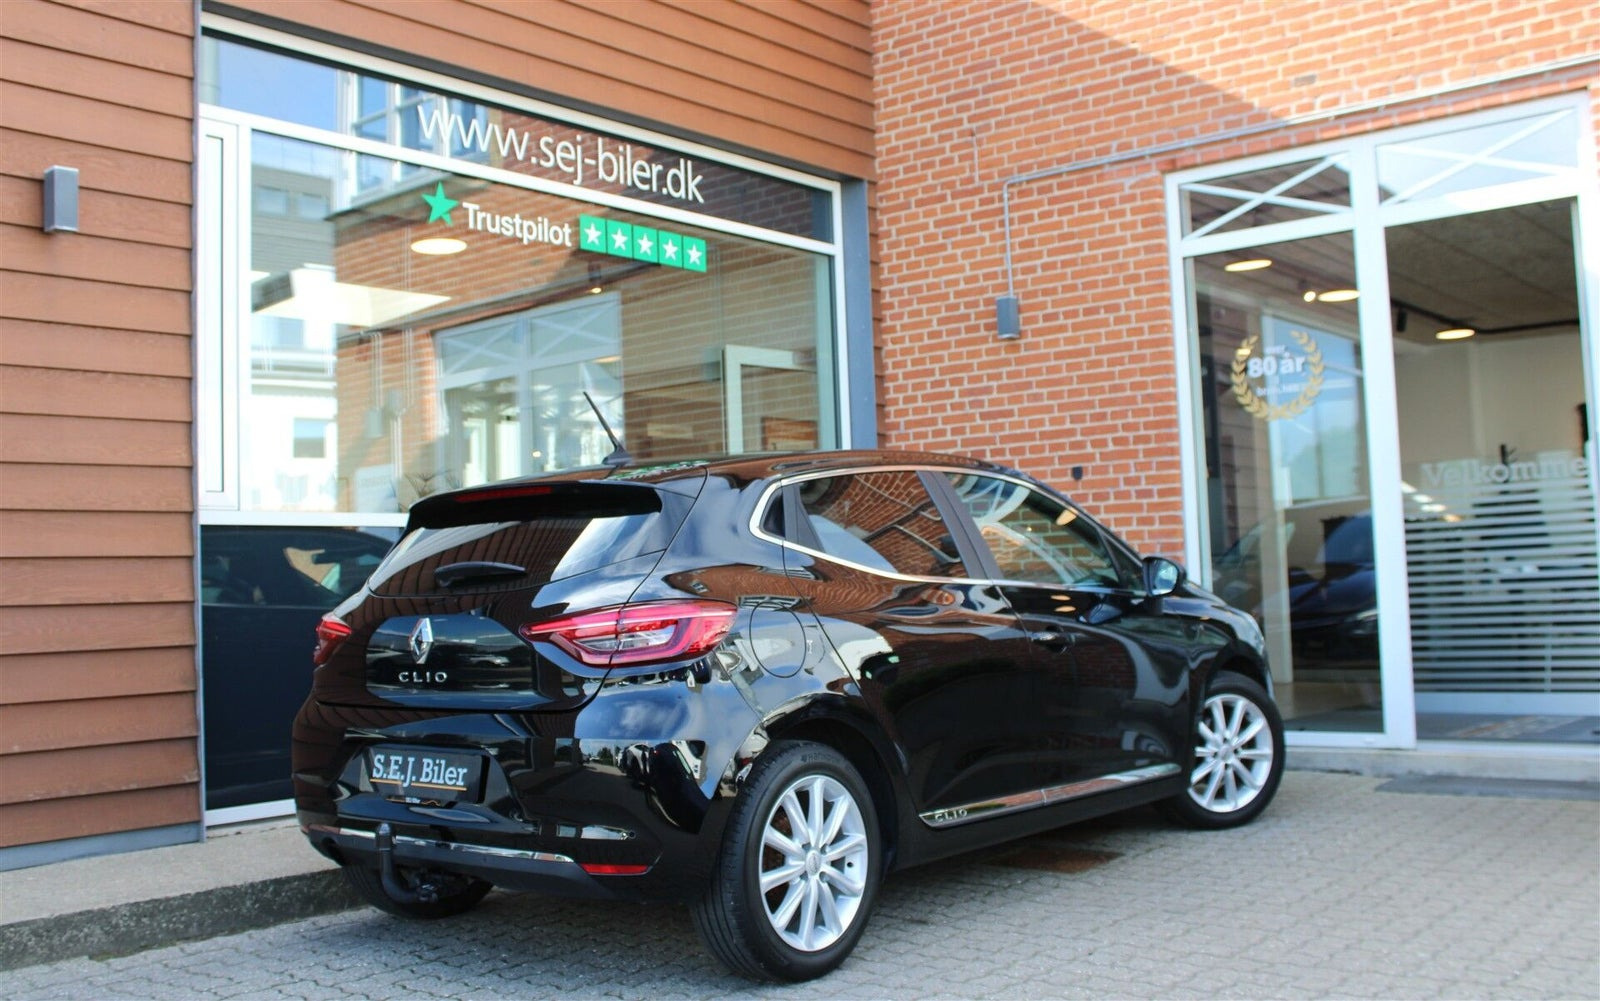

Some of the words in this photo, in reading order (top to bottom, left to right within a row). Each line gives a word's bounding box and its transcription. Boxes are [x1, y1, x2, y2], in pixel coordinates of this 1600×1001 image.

[417, 102, 705, 204] www.sej-biler.dk
[462, 202, 572, 248] Trustpilot
[1247, 355, 1278, 379] 80
[1280, 351, 1307, 375] år
[398, 671, 448, 683] CLIO
[372, 753, 417, 788] S.E.J.
[419, 757, 468, 786] Biler
[934, 808, 968, 822] CLIO
